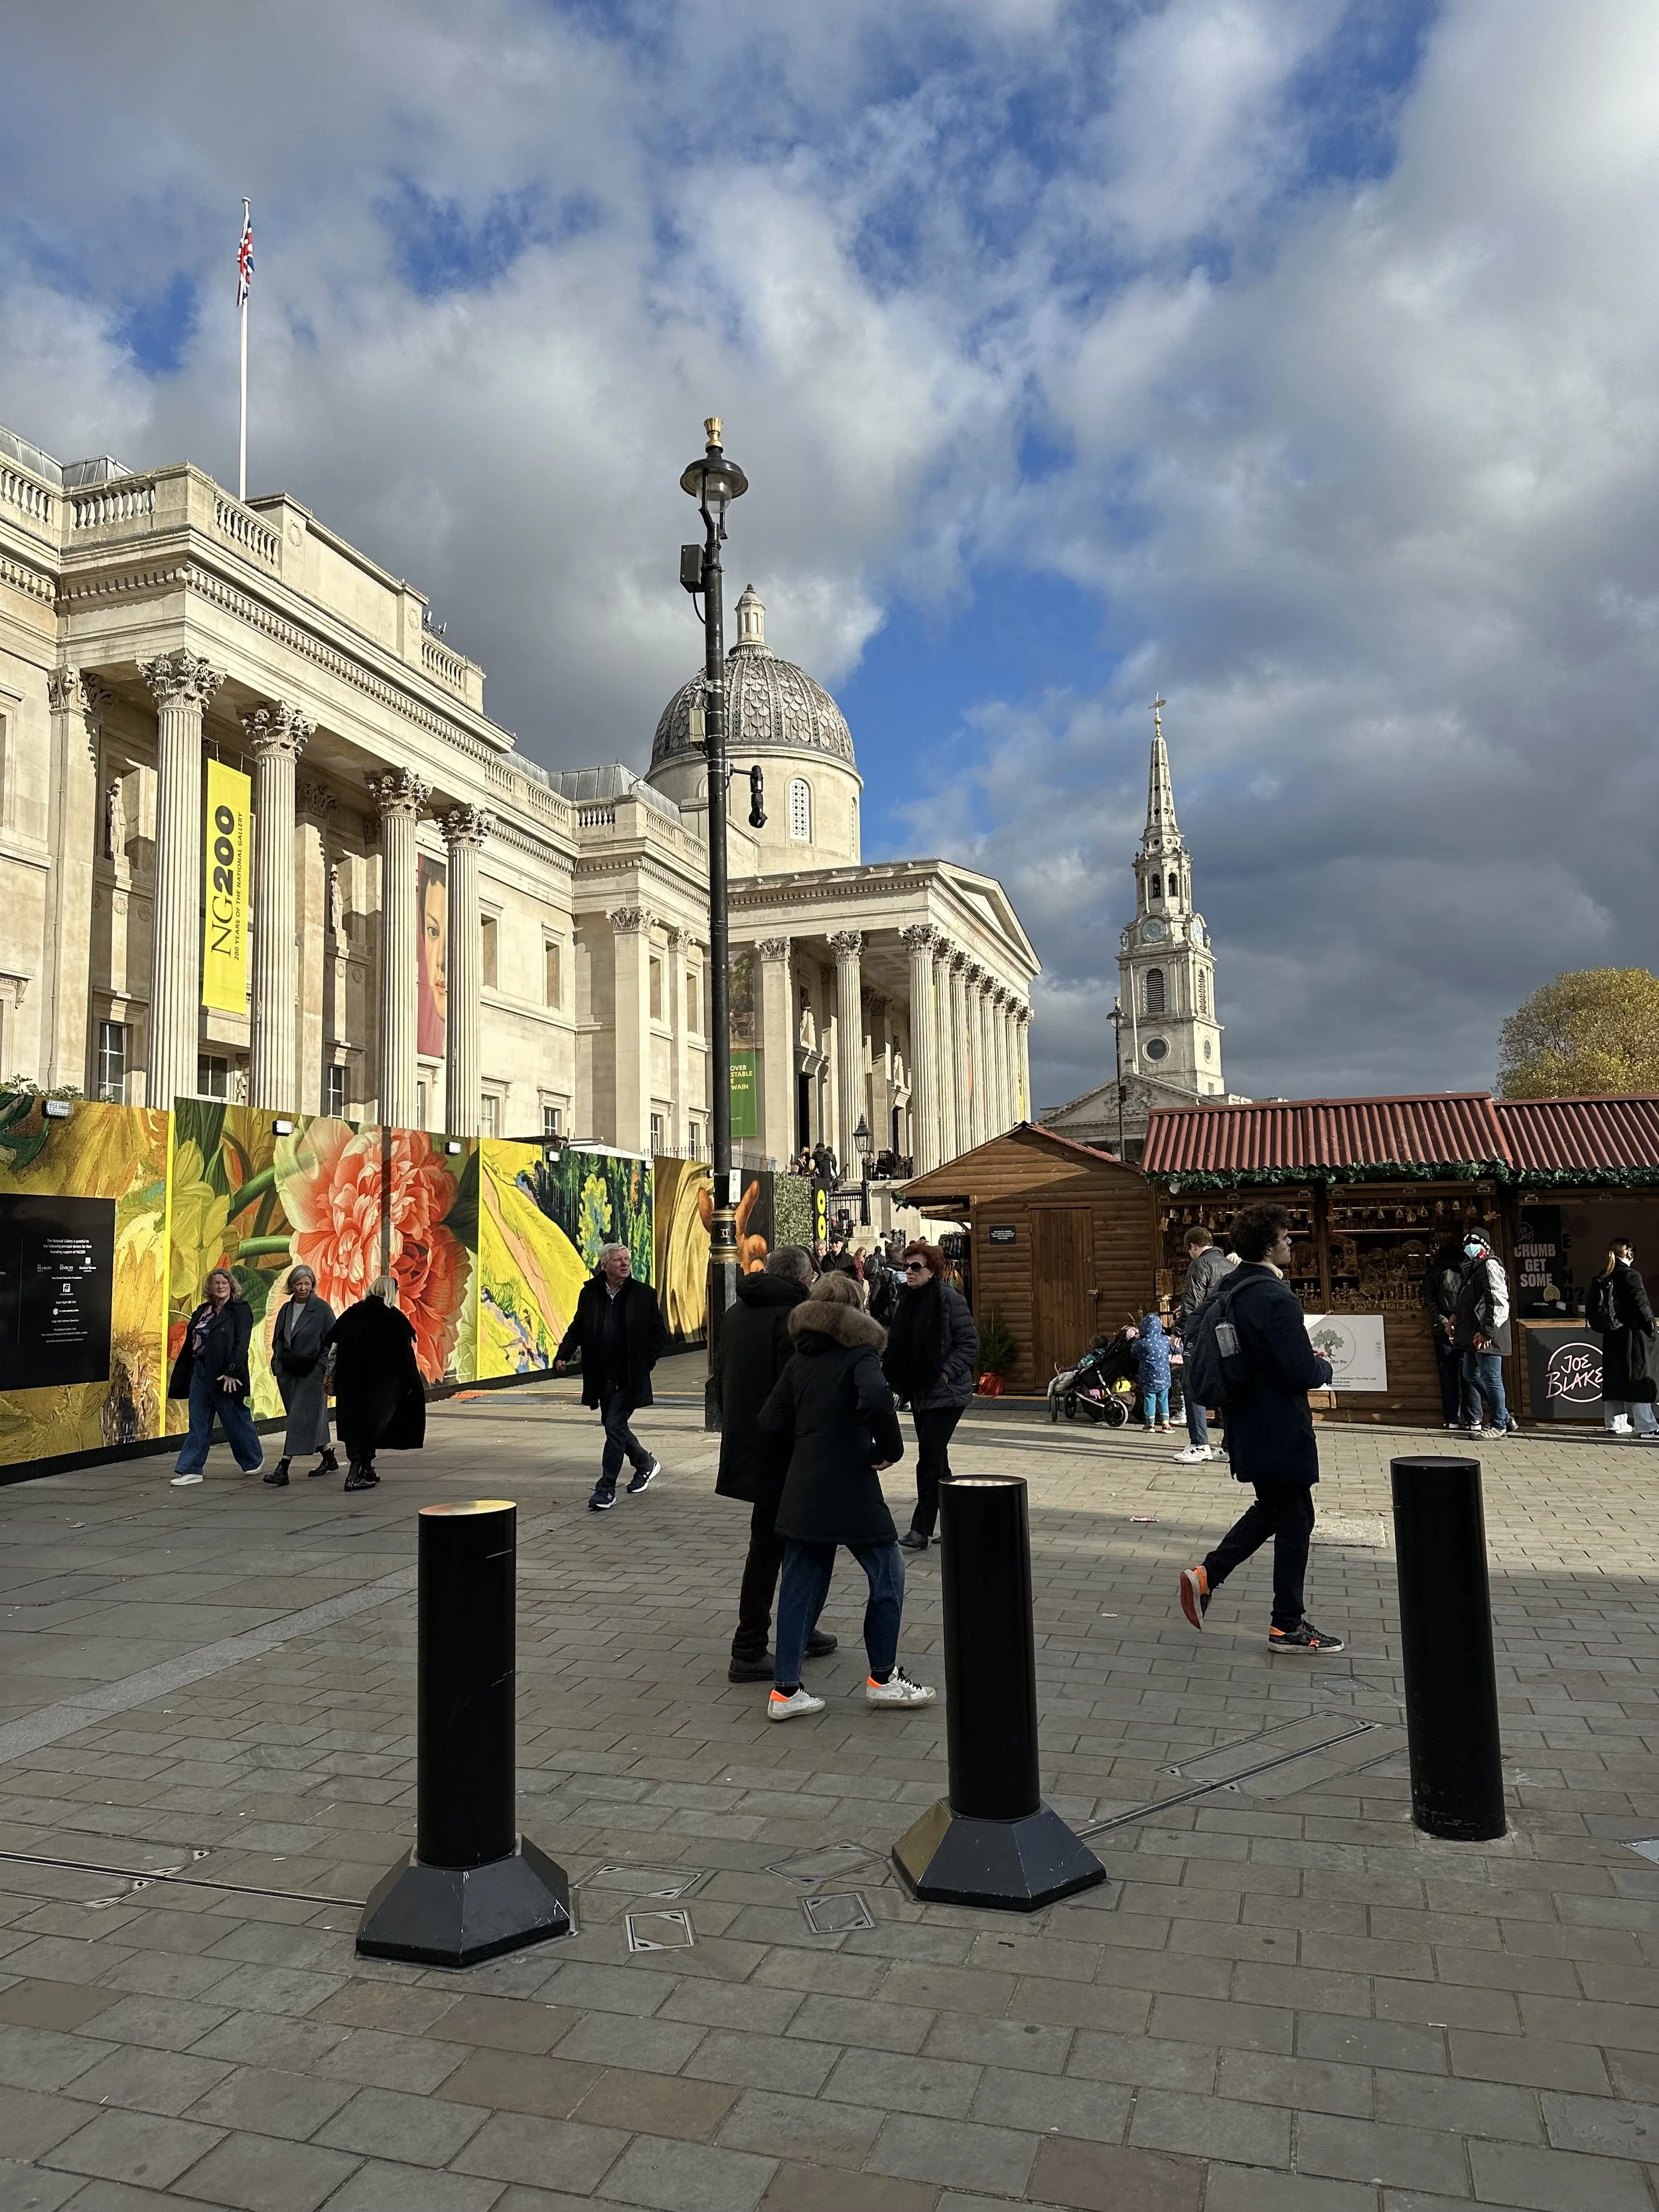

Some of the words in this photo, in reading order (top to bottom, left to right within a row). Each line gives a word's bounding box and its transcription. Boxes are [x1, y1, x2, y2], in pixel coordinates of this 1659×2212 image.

[211, 805, 235, 958] NG200
[236, 907, 240, 917] OF
[1514, 1243, 1555, 1258] CRUMB
[1525, 1258, 1546, 1272] GET
[1520, 1273, 1553, 1288] SOME
[1560, 1354, 1592, 1373] JOE
[1546, 1366, 1603, 1398] BLAKE
